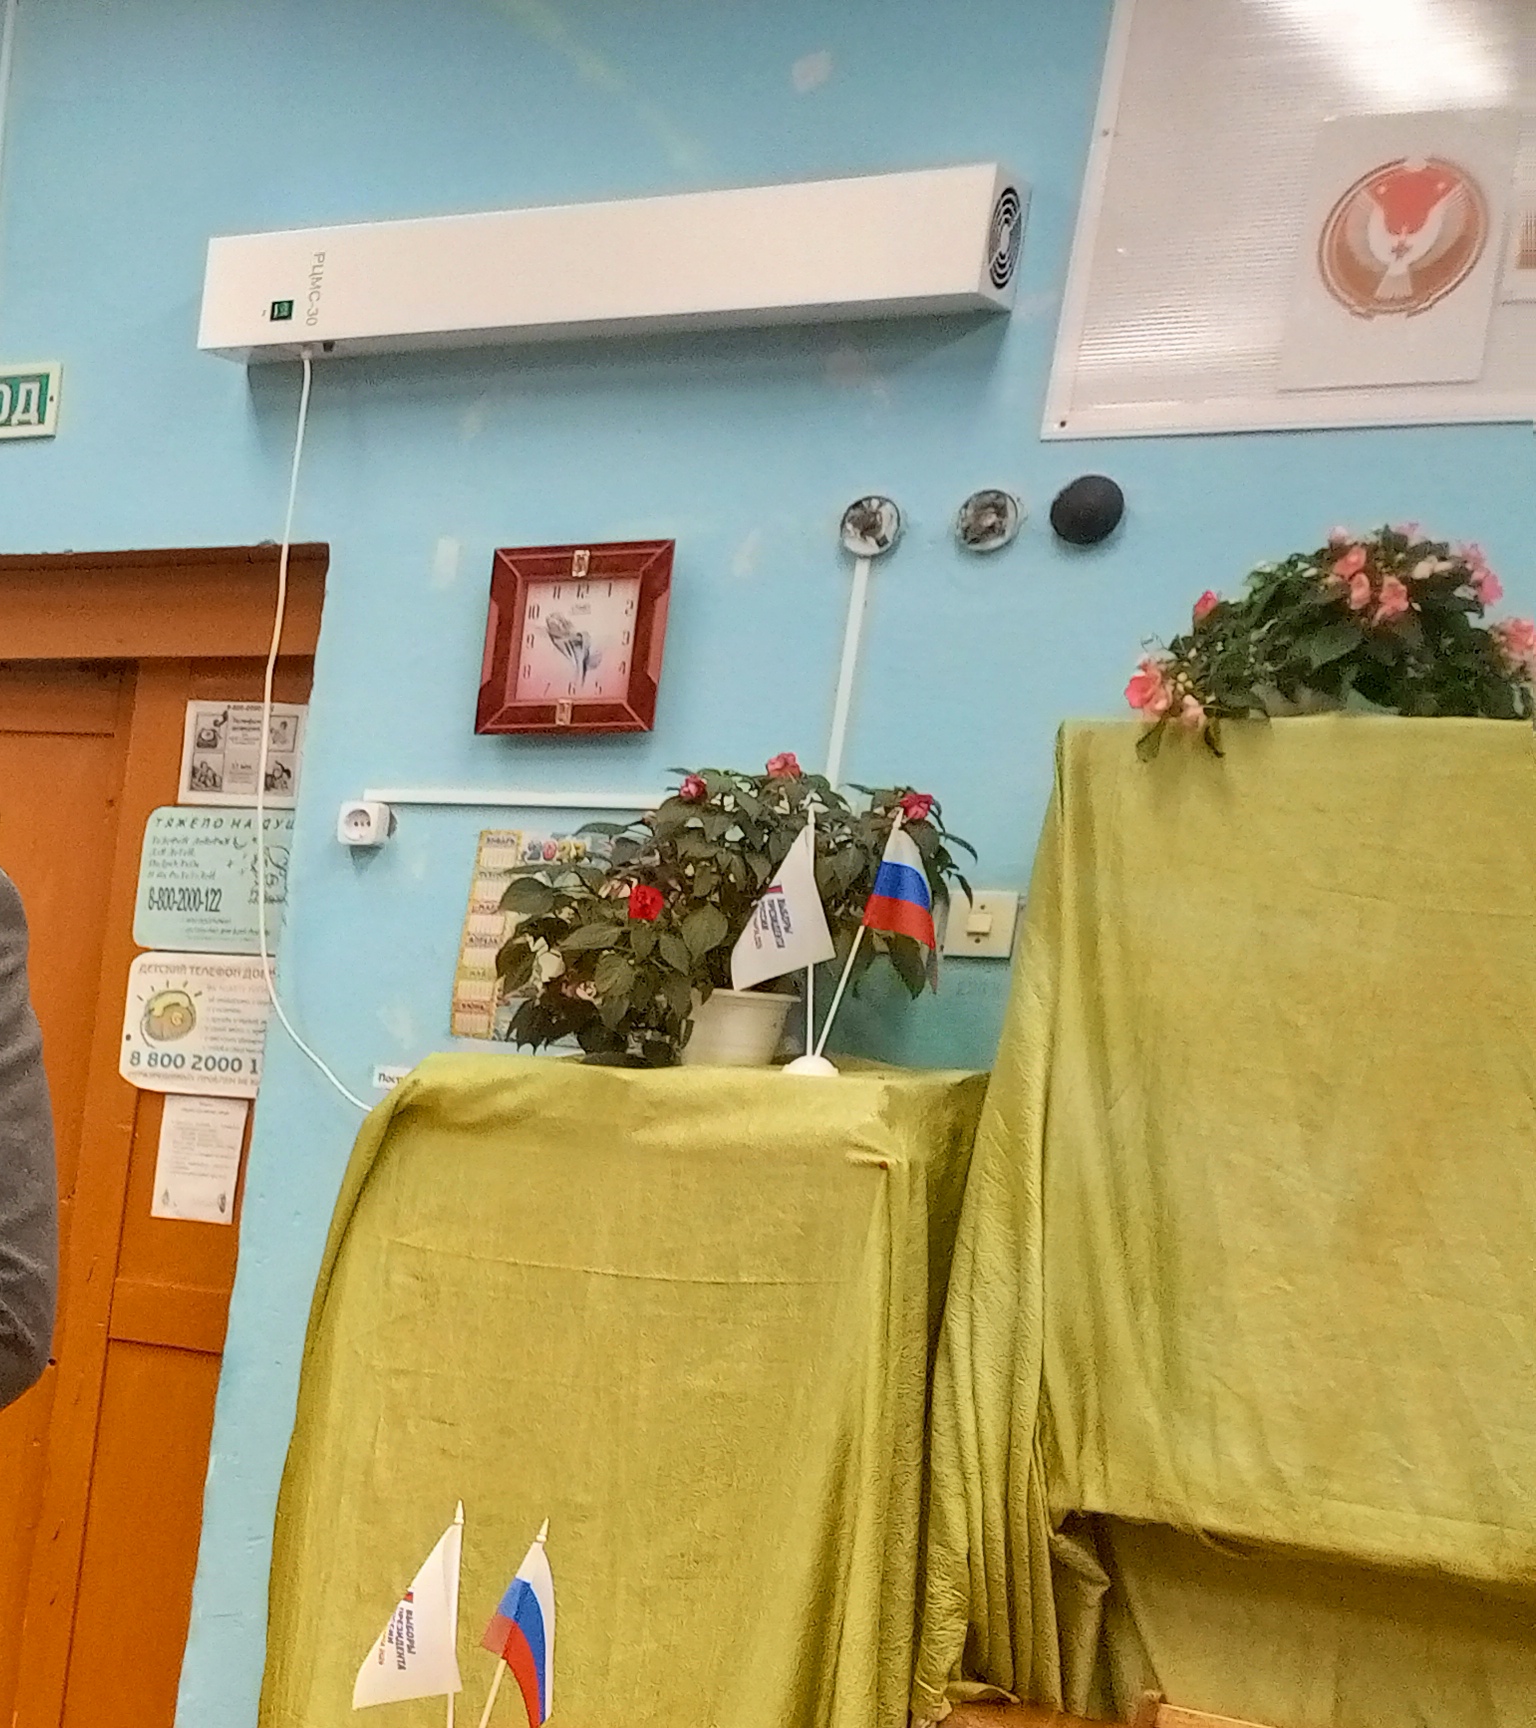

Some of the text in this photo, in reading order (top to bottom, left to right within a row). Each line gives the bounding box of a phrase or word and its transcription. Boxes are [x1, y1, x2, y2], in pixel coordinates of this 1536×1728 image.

[230, 817, 253, 829] НА
[129, 1051, 259, 1075] 8 800 2000 1
